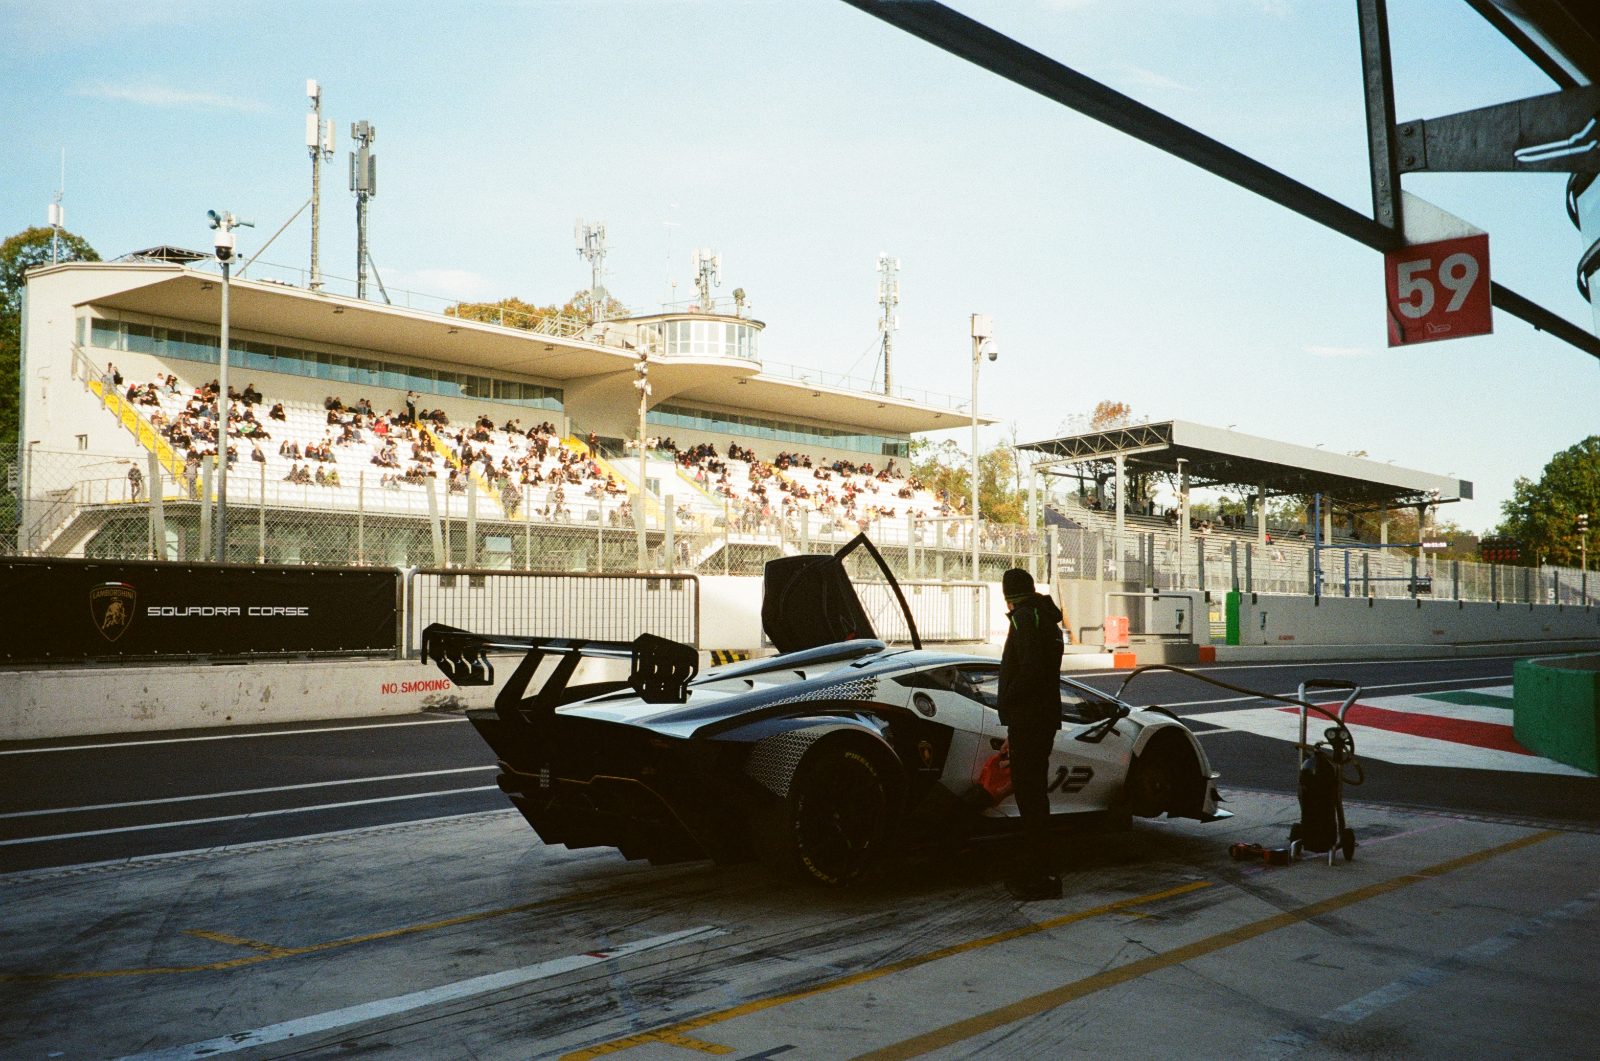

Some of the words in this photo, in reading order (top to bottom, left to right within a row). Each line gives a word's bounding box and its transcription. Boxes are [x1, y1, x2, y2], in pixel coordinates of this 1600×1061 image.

[1397, 252, 1479, 319] 59
[92, 589, 134, 600] LAMBORGHINI
[147, 606, 240, 616] SQUADRA
[248, 606, 309, 616] CORSE
[381, 682, 398, 694] NO
[401, 679, 451, 693] SMOKING
[1048, 765, 1094, 793] 12
